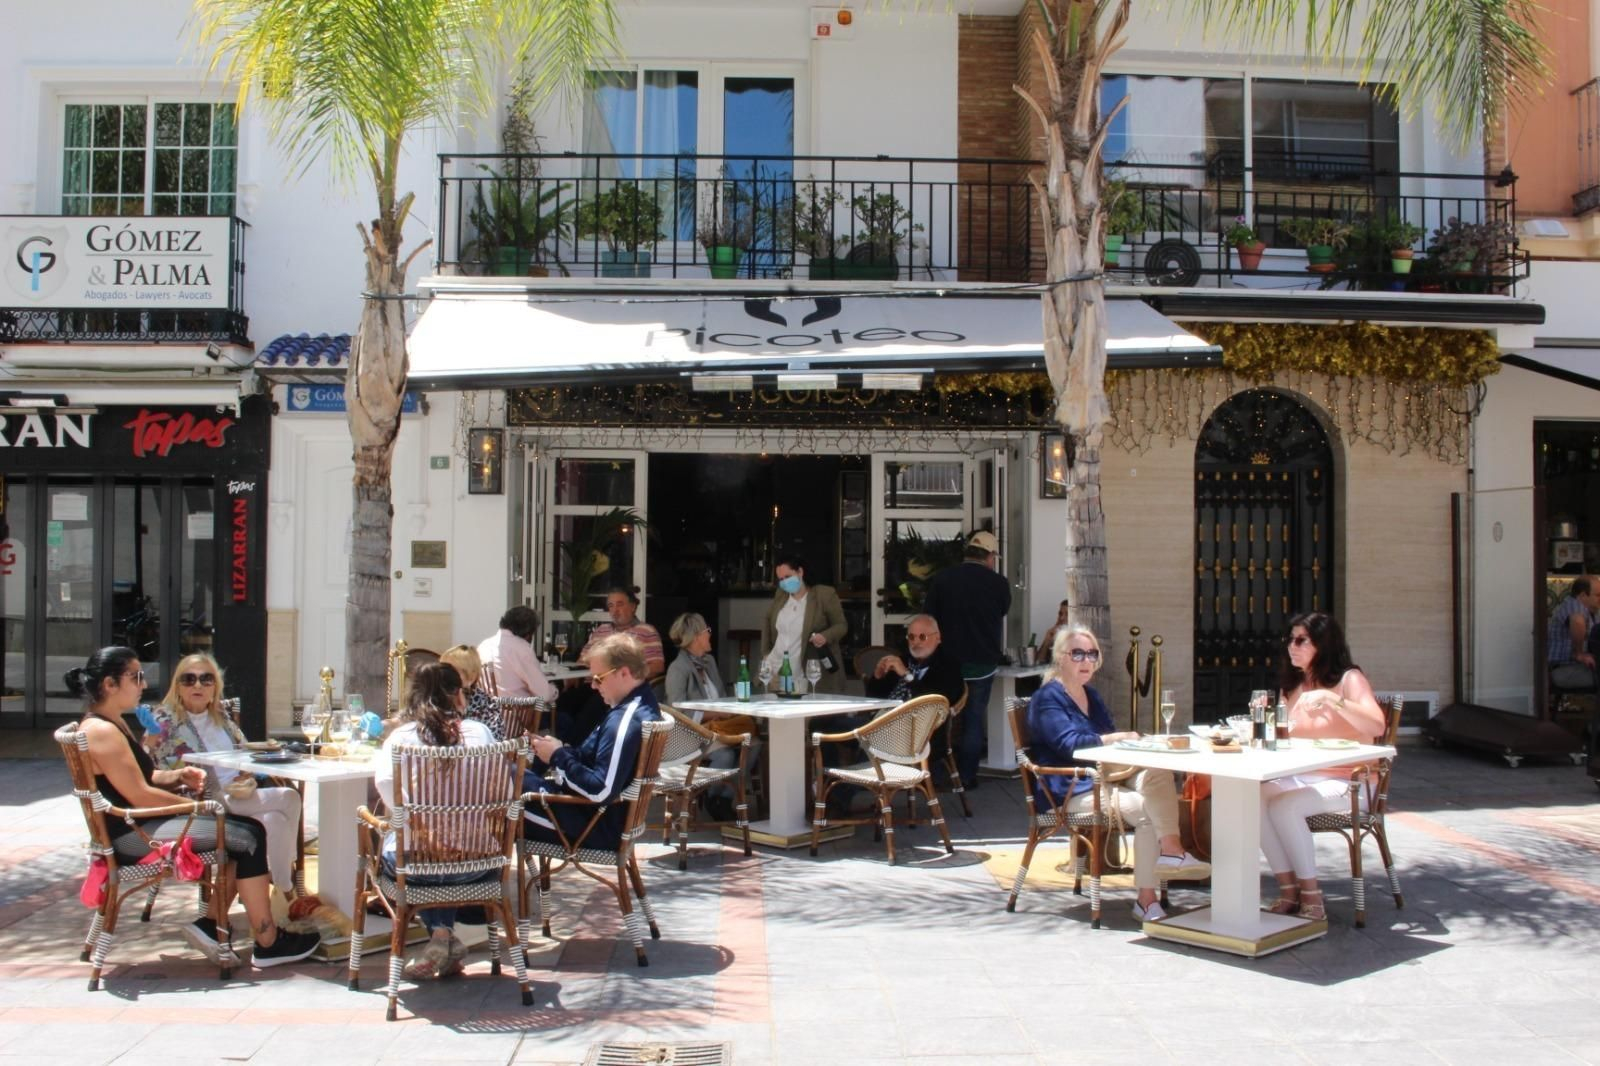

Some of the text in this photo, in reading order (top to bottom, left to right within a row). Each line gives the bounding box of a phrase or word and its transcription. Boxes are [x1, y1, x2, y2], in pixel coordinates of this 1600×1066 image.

[86, 223, 202, 253] GÓMEZ
[88, 259, 212, 286] & PALMA
[84, 290, 127, 301] Abogados
[135, 290, 170, 300] Lawyers
[178, 290, 212, 300] Avocats
[123, 407, 235, 458] tapas
[227, 480, 256, 495] tapas
[232, 499, 248, 601] LIZARRAN
